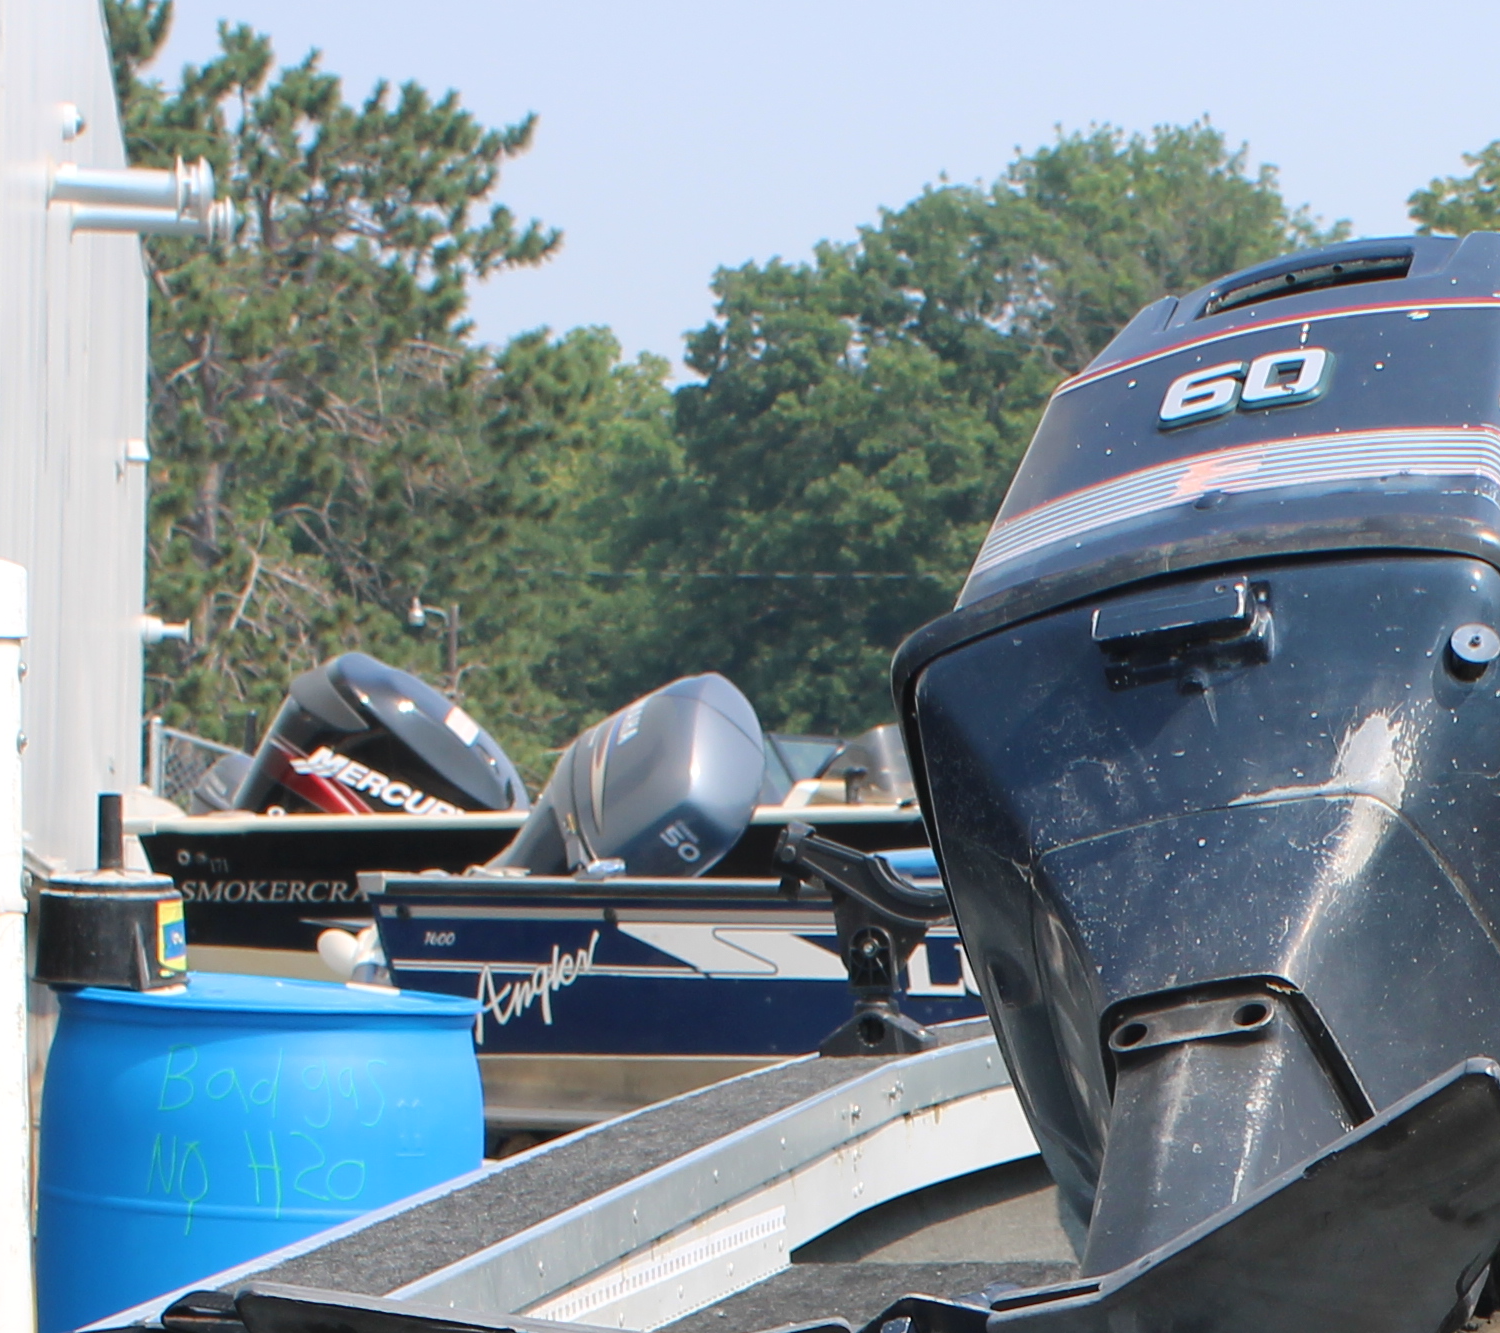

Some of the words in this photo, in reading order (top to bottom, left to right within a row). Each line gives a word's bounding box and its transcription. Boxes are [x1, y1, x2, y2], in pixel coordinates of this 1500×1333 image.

[1159, 348, 1329, 424] 60
[290, 746, 466, 815] MERCUR
[659, 825, 700, 863] 50
[182, 879, 371, 902] SMOKERCRA
[475, 929, 599, 1045] Angler
[158, 1043, 283, 1119] Bad
